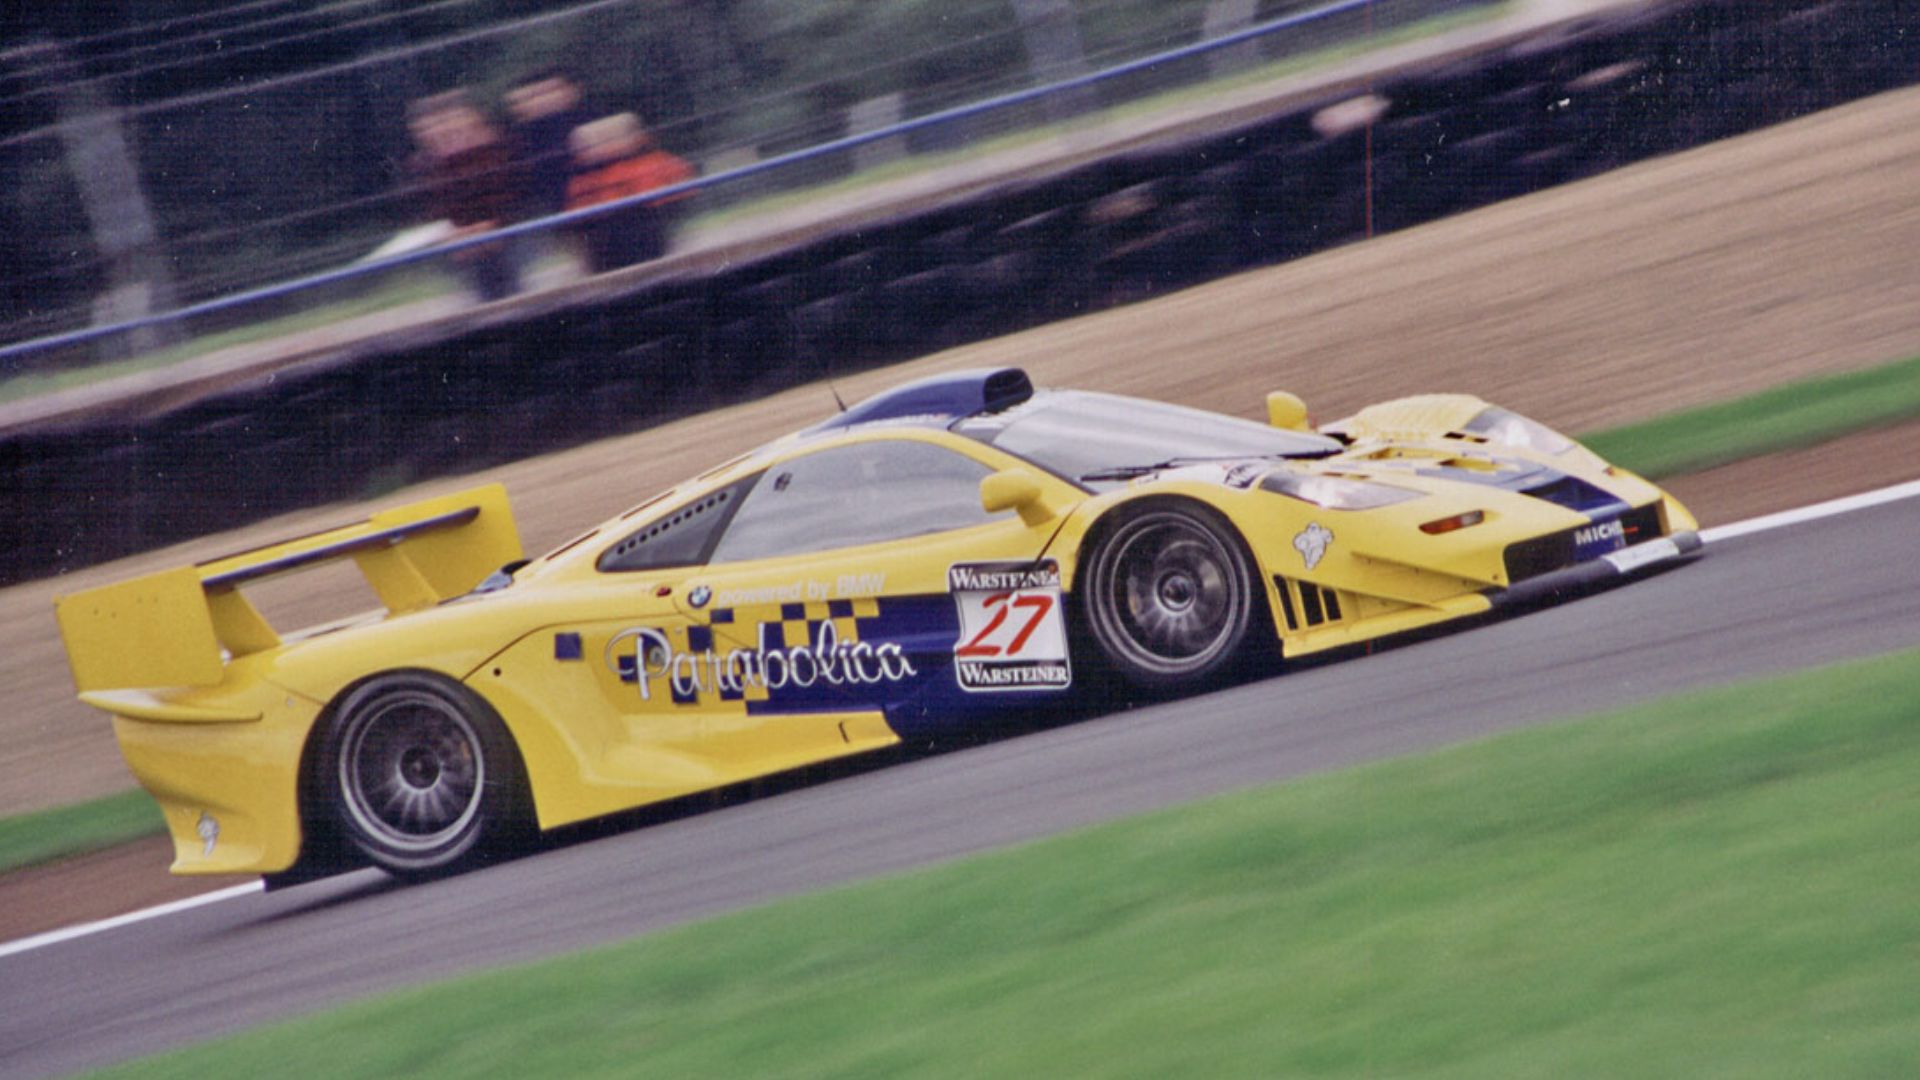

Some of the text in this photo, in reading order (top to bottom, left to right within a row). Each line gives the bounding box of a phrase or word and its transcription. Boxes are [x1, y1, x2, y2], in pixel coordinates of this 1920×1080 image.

[719, 571, 886, 608] powered by BMW
[956, 593, 1053, 655] 27
[606, 619, 917, 700] Parabolica
[962, 663, 1066, 682] WARSTEINER
